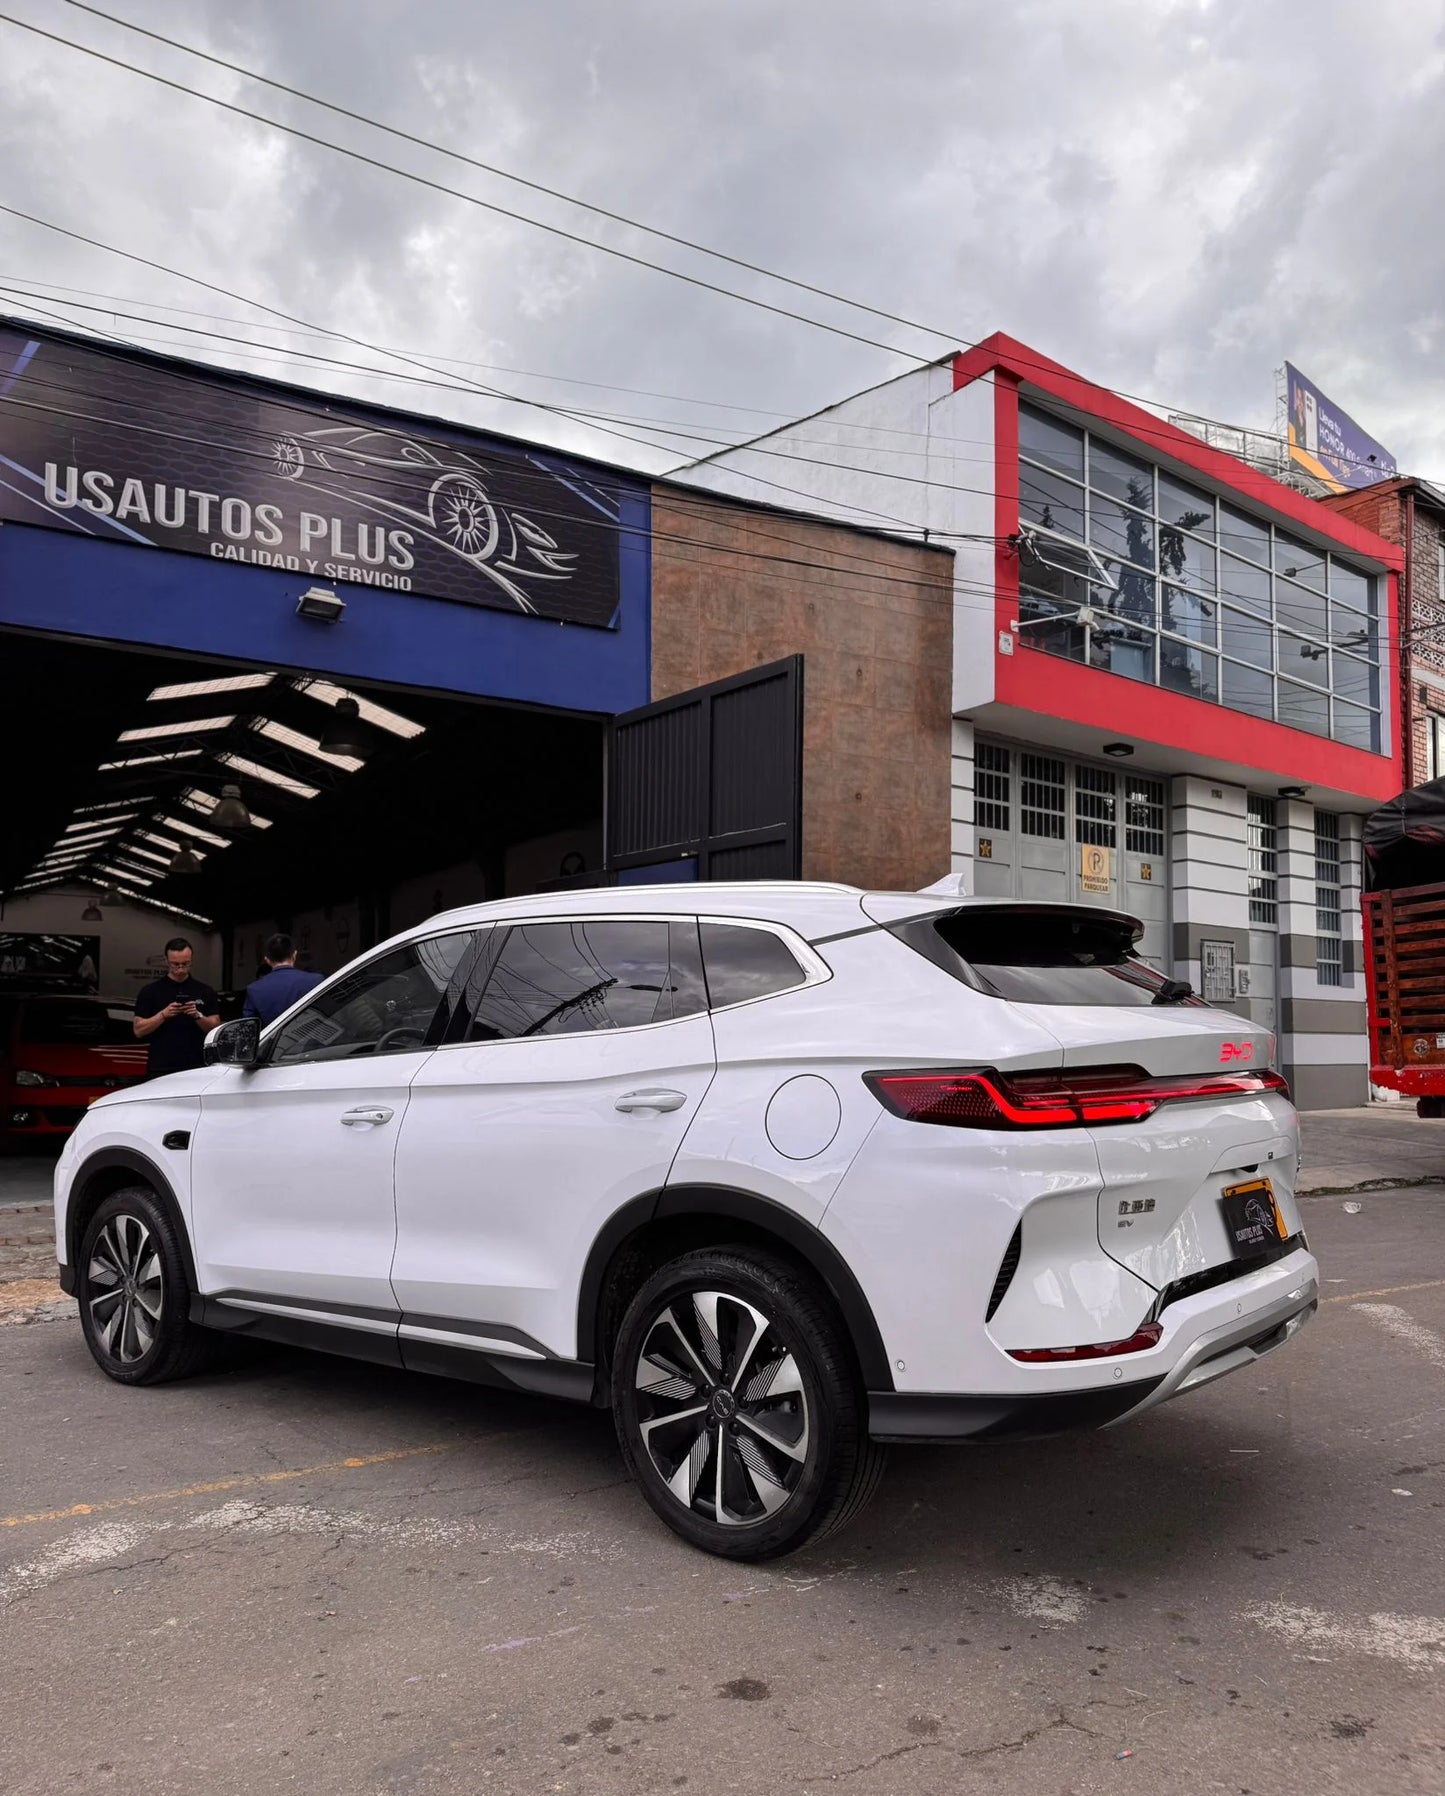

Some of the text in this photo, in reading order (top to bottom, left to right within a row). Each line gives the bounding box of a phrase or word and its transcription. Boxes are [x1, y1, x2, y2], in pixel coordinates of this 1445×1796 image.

[1319, 424, 1345, 457] HONOR
[44, 462, 414, 571] USAUTOS PLUS
[210, 542, 412, 591] CALIDAD Y SERVICIO
[1083, 875, 1107, 884] PROHIBIDO
[1084, 883, 1108, 891] PARQUEAR
[1219, 1041, 1252, 1061] BYD
[1118, 1217, 1134, 1228] EV
